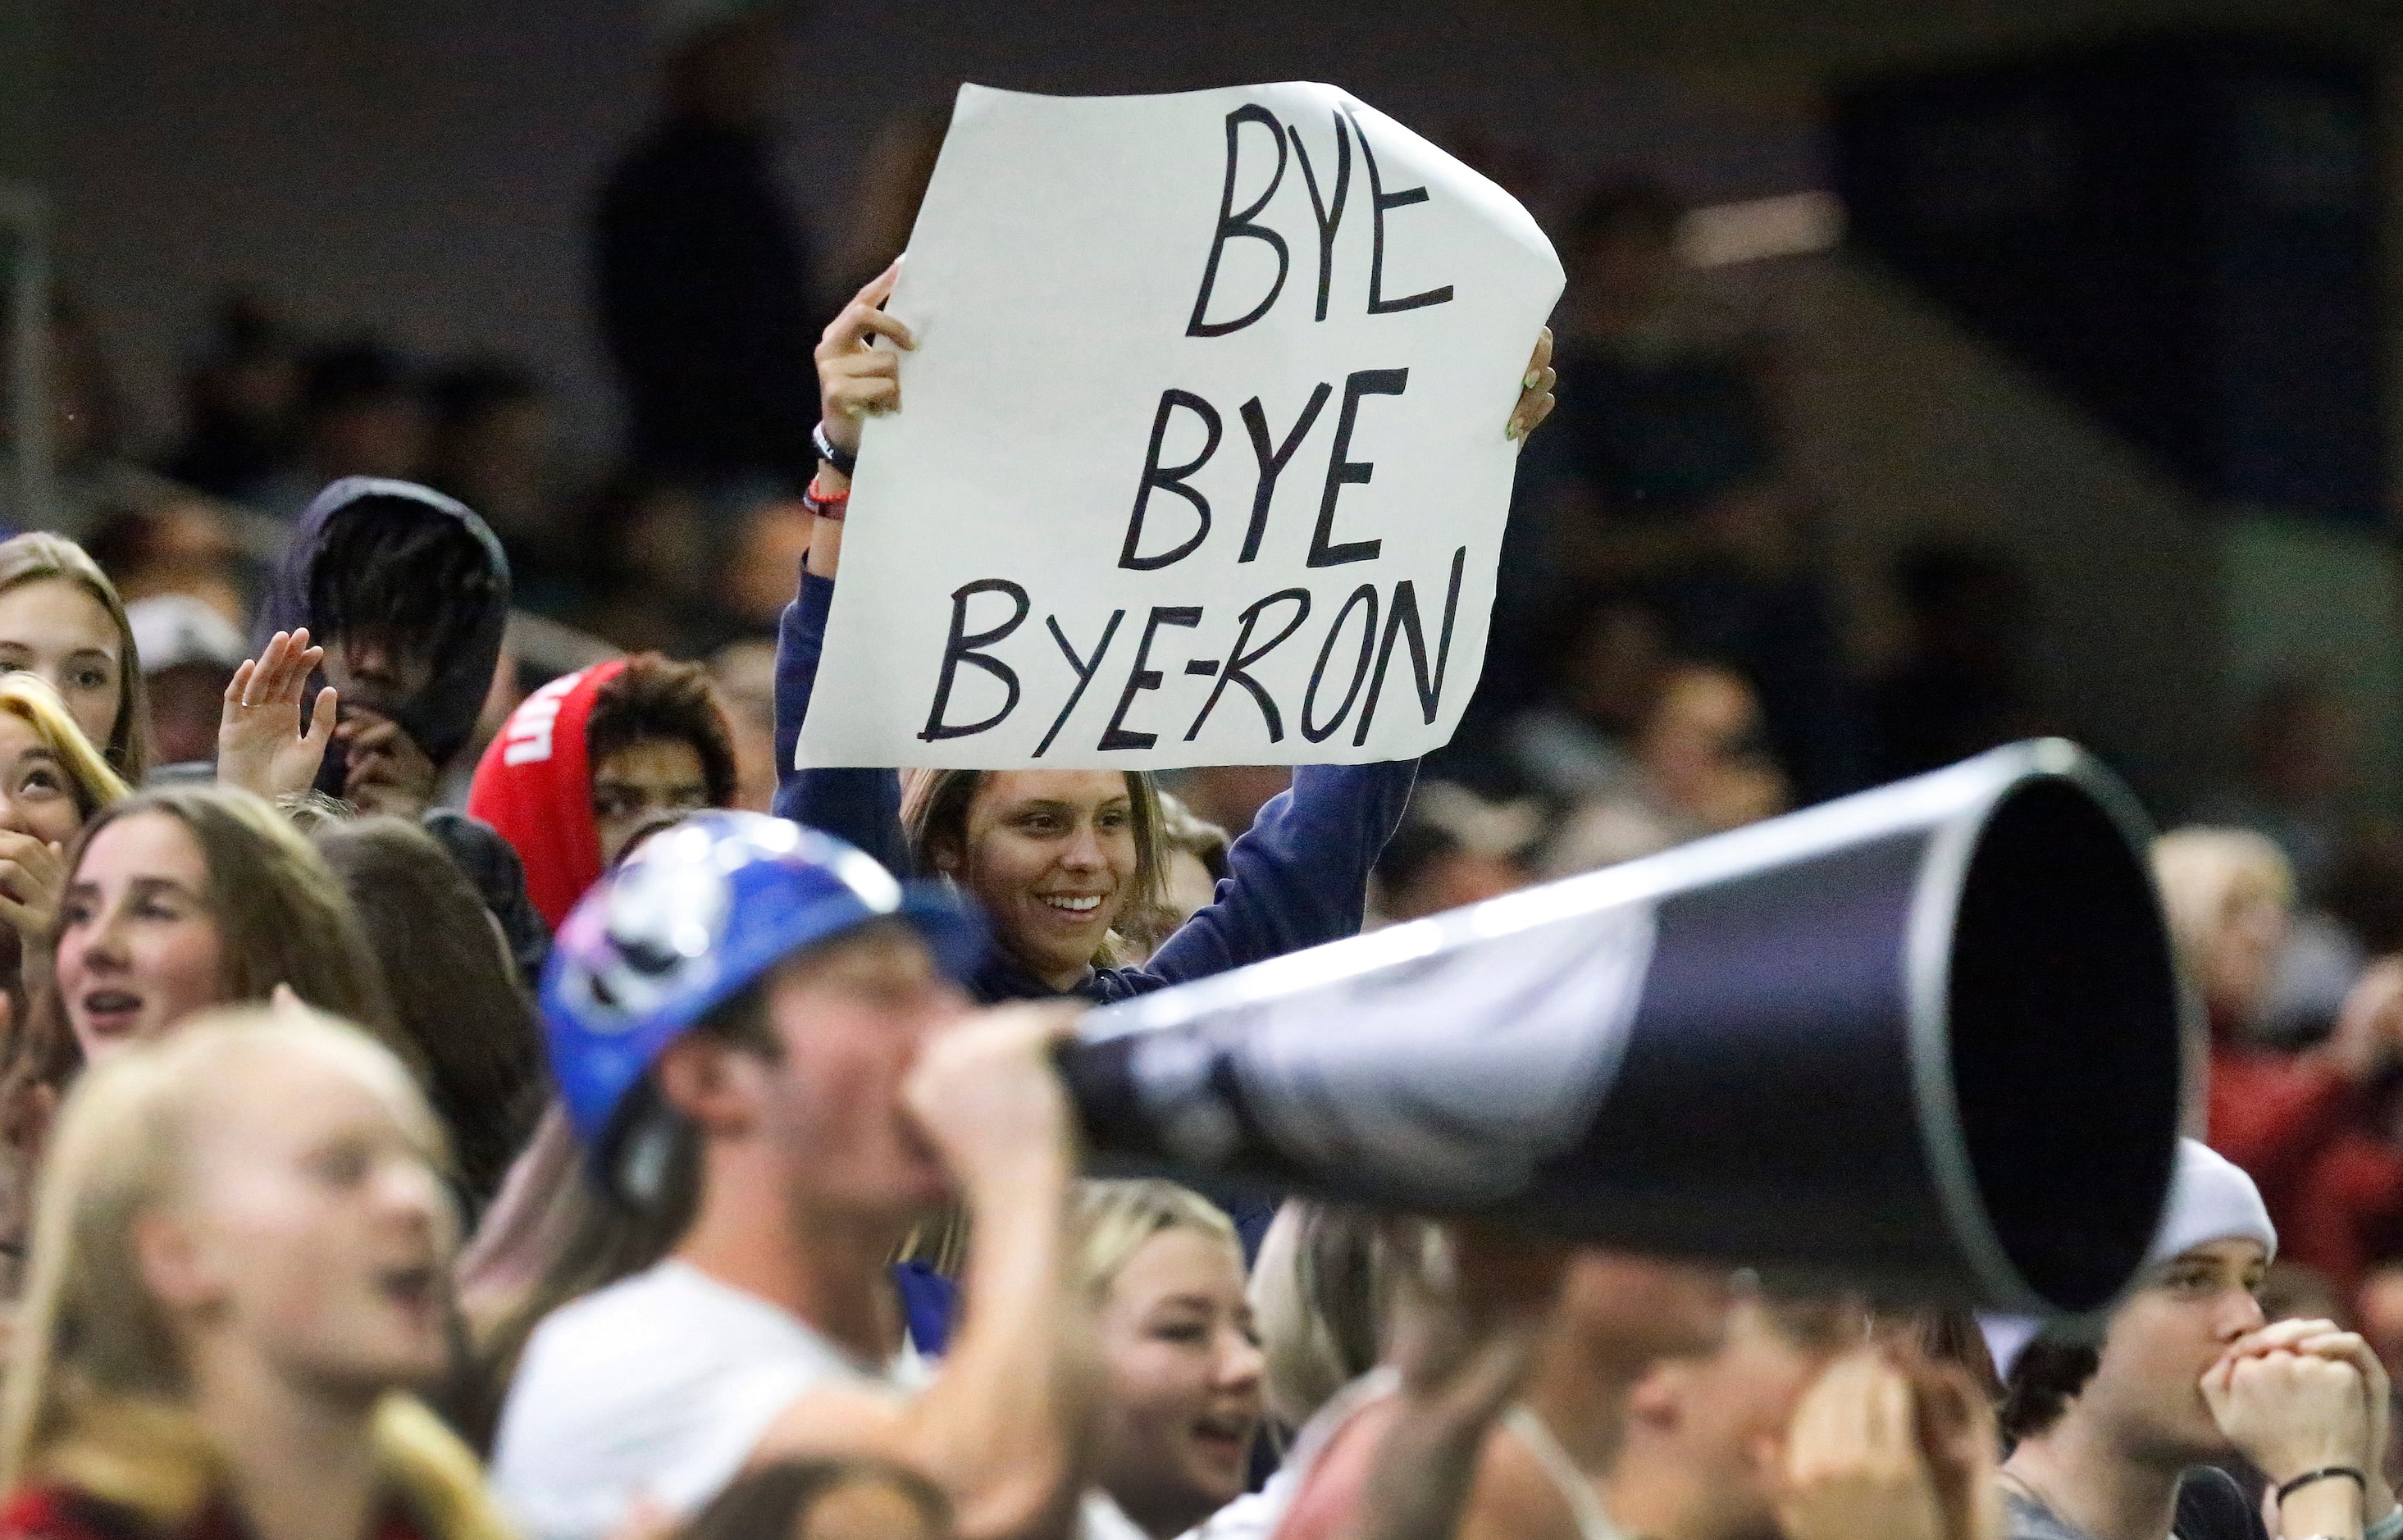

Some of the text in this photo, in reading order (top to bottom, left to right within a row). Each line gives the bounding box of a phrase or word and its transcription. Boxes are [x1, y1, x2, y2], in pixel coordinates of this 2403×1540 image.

[1185, 101, 1453, 337] BYE
[1118, 368, 1408, 571] BYE
[917, 546, 1466, 758] BYE-RON
